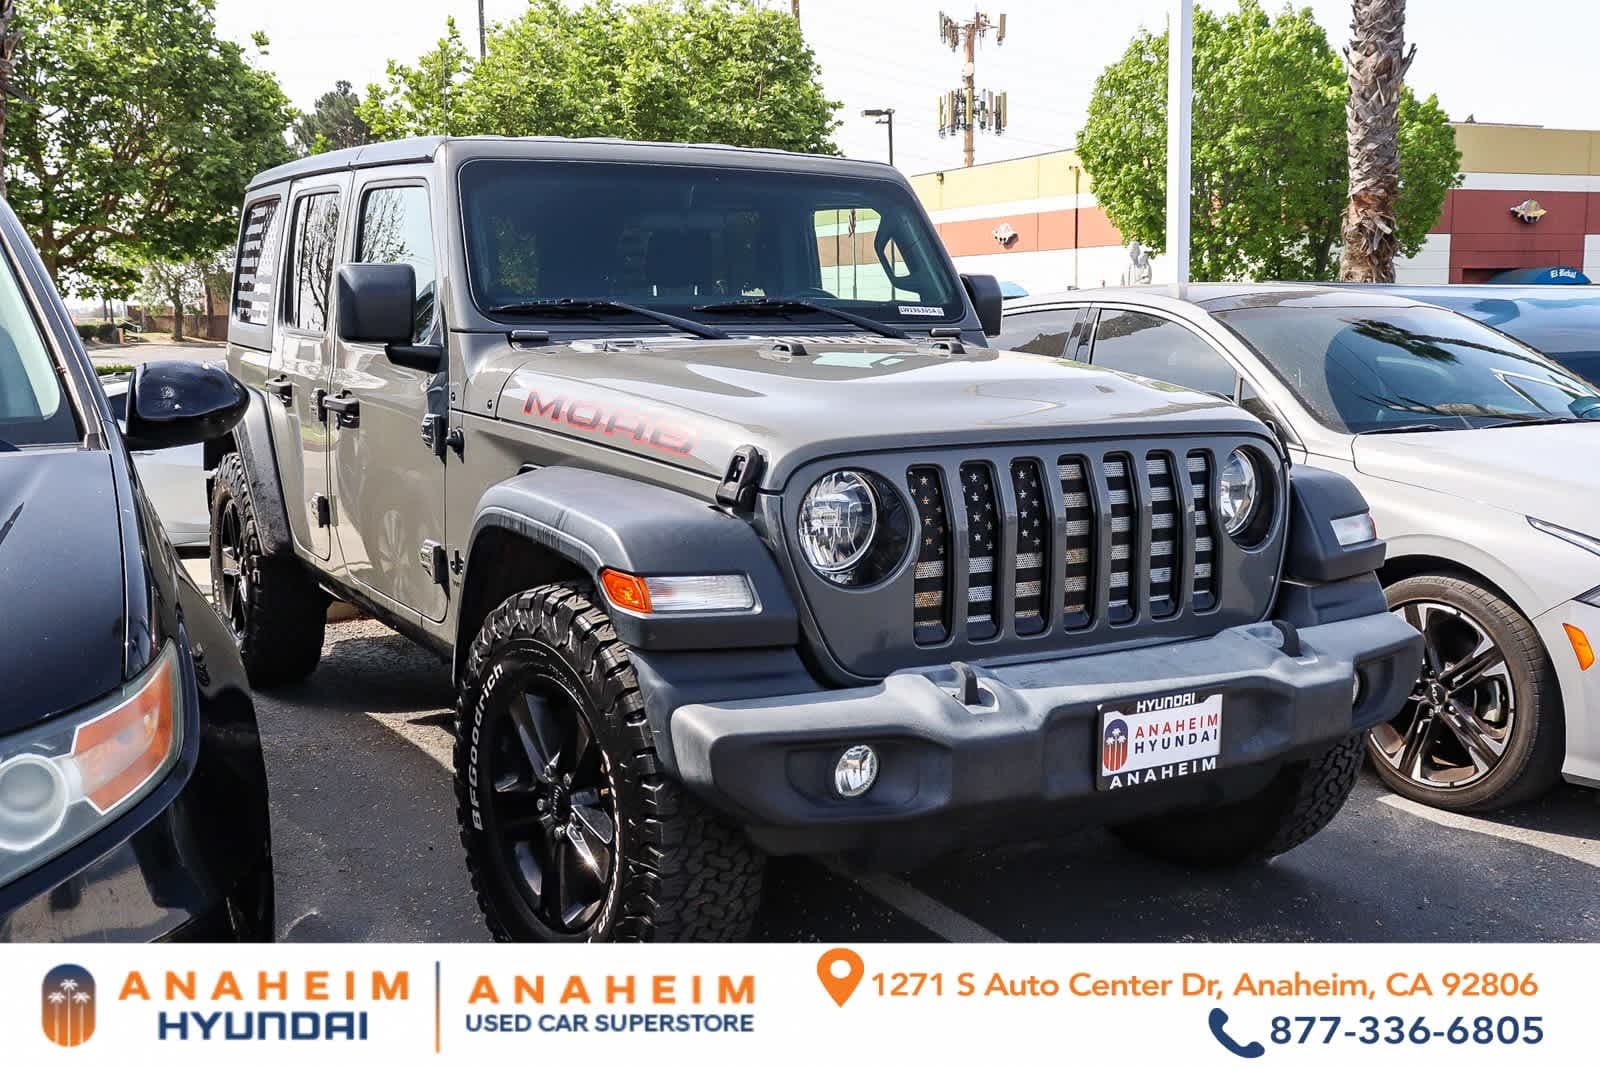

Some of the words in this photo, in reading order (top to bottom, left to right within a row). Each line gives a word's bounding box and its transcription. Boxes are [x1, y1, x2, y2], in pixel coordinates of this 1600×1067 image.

[1136, 692, 1196, 713] HYUNDAI
[1135, 713, 1218, 739] ANAHEIM
[468, 663, 504, 831] BFGoodrich
[1135, 729, 1217, 754] HYUNDAI
[1109, 756, 1217, 790] ANAHEIM
